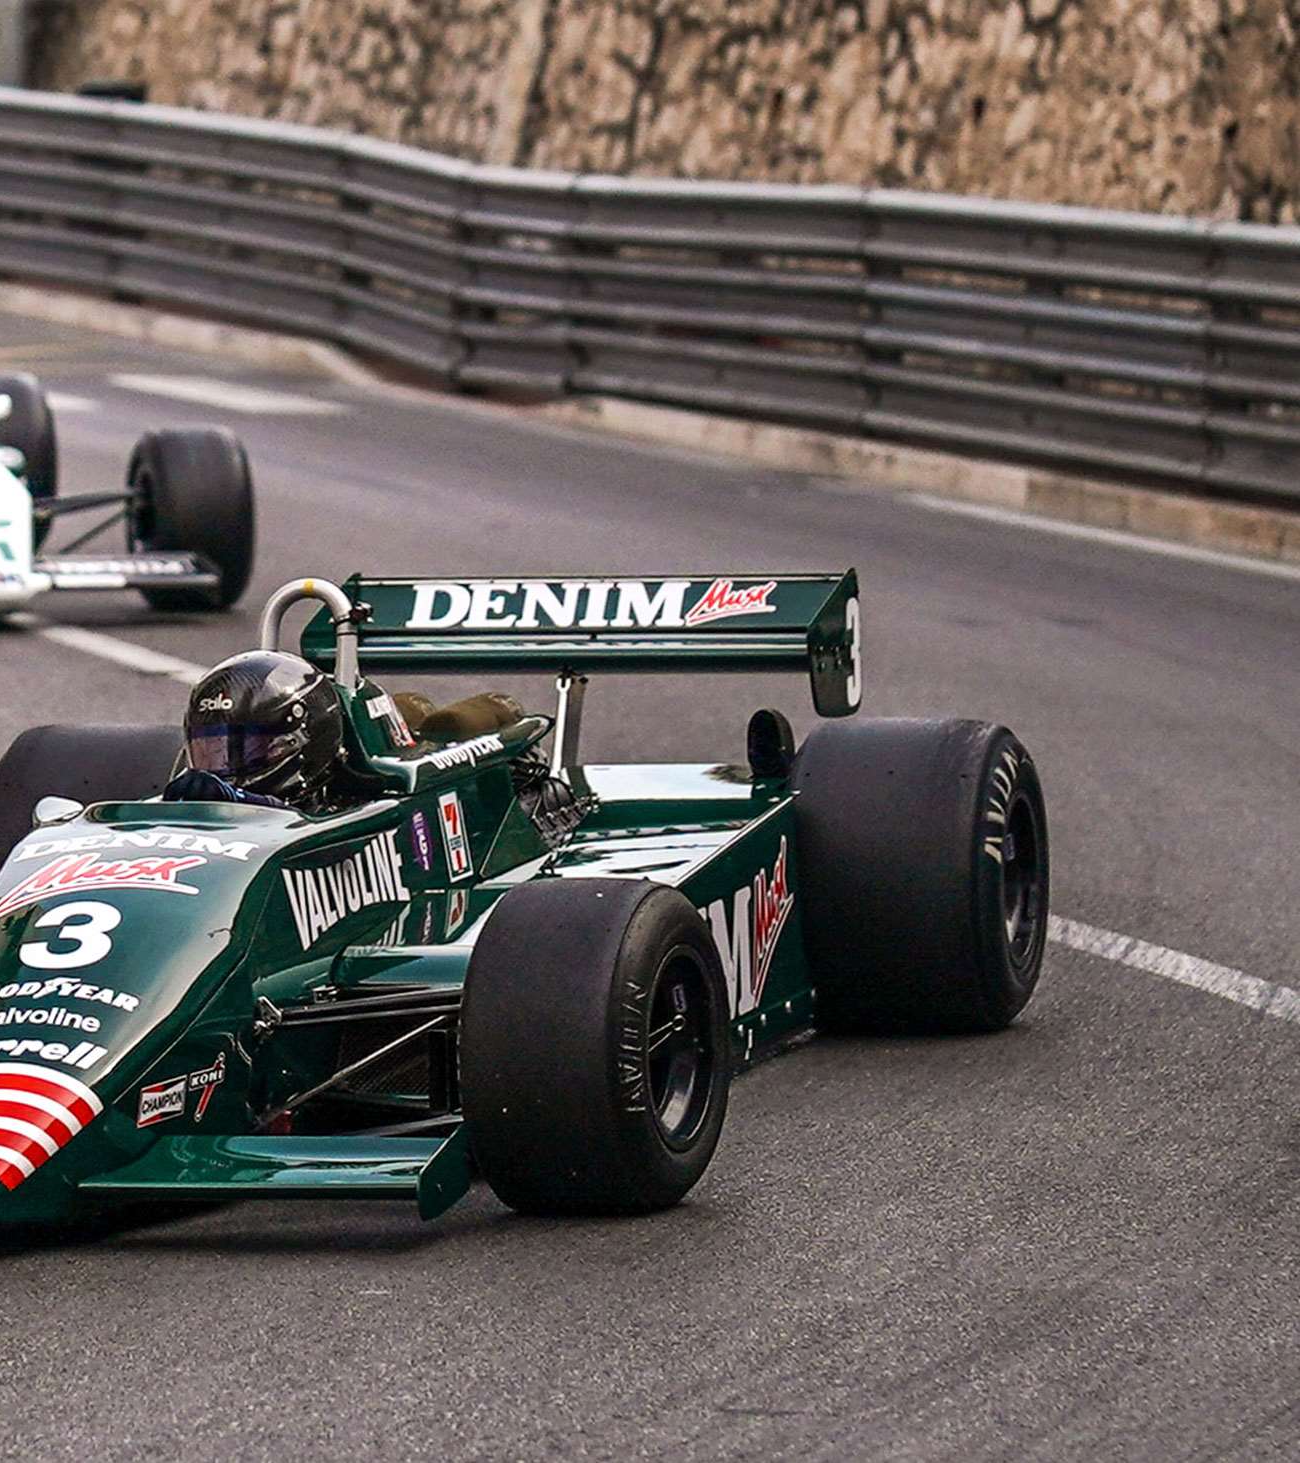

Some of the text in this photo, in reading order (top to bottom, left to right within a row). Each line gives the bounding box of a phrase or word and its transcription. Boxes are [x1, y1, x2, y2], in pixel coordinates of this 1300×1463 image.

[405, 582, 692, 629] DENIM
[846, 596, 862, 708] 3
[13, 831, 259, 862] DENIM
[281, 828, 411, 952] VALVOLINE
[19, 899, 123, 970] 3
[190, 1068, 224, 1088] KONI
